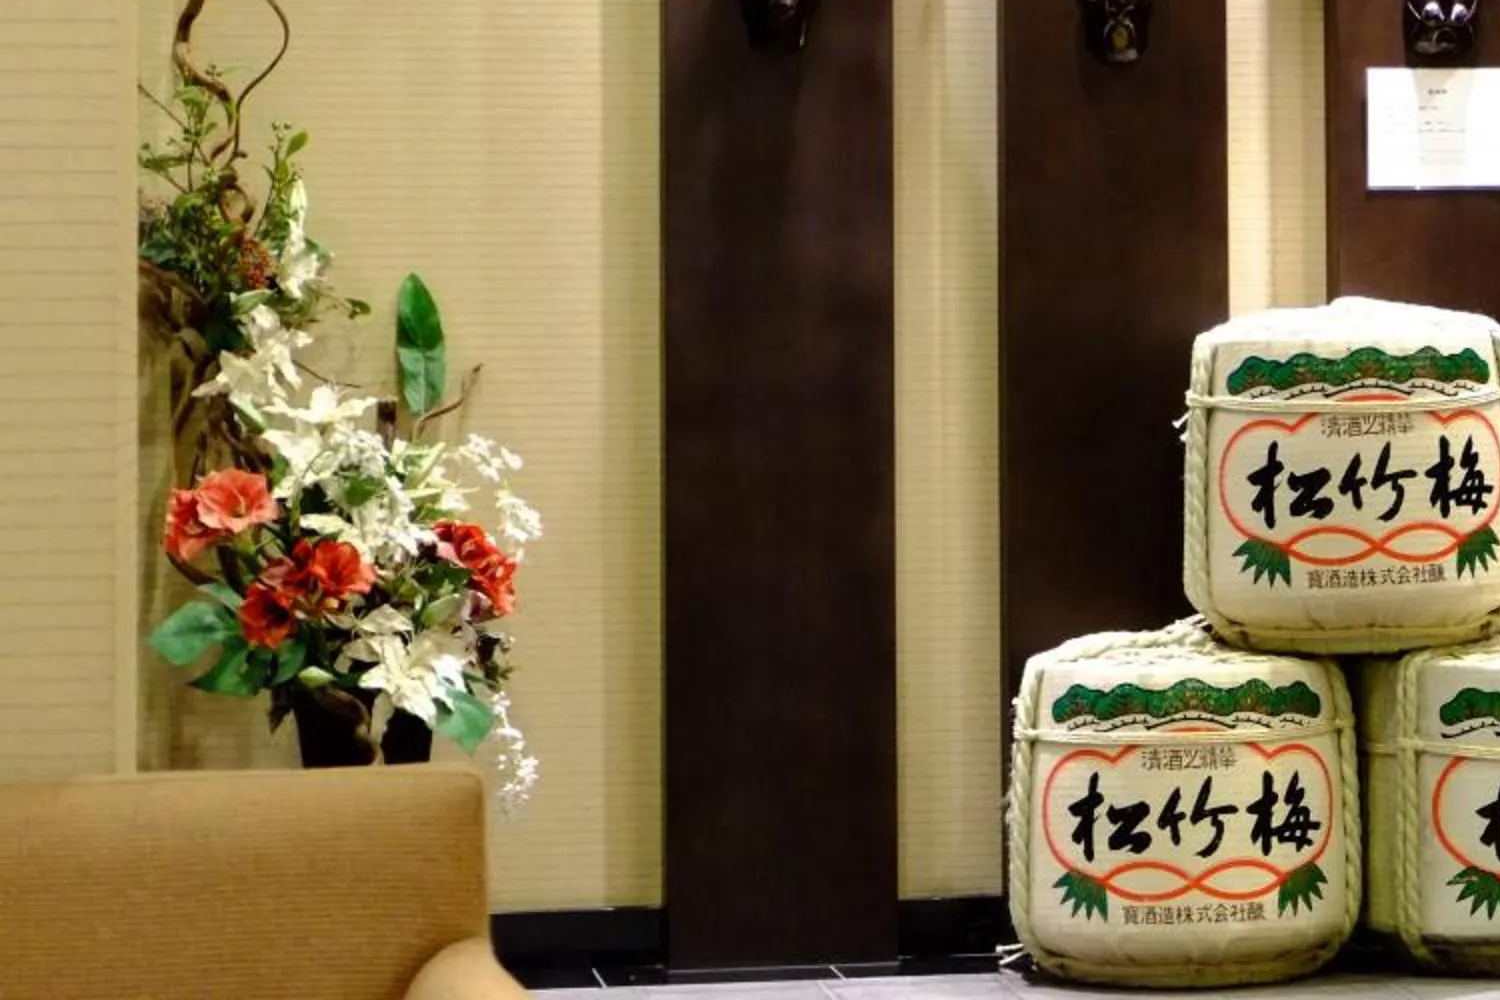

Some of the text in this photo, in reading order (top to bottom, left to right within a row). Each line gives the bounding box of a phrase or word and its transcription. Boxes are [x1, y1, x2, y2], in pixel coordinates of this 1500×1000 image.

[1247, 435, 1493, 529] 松竹梅
[1068, 771, 1321, 862] 松竹梅
